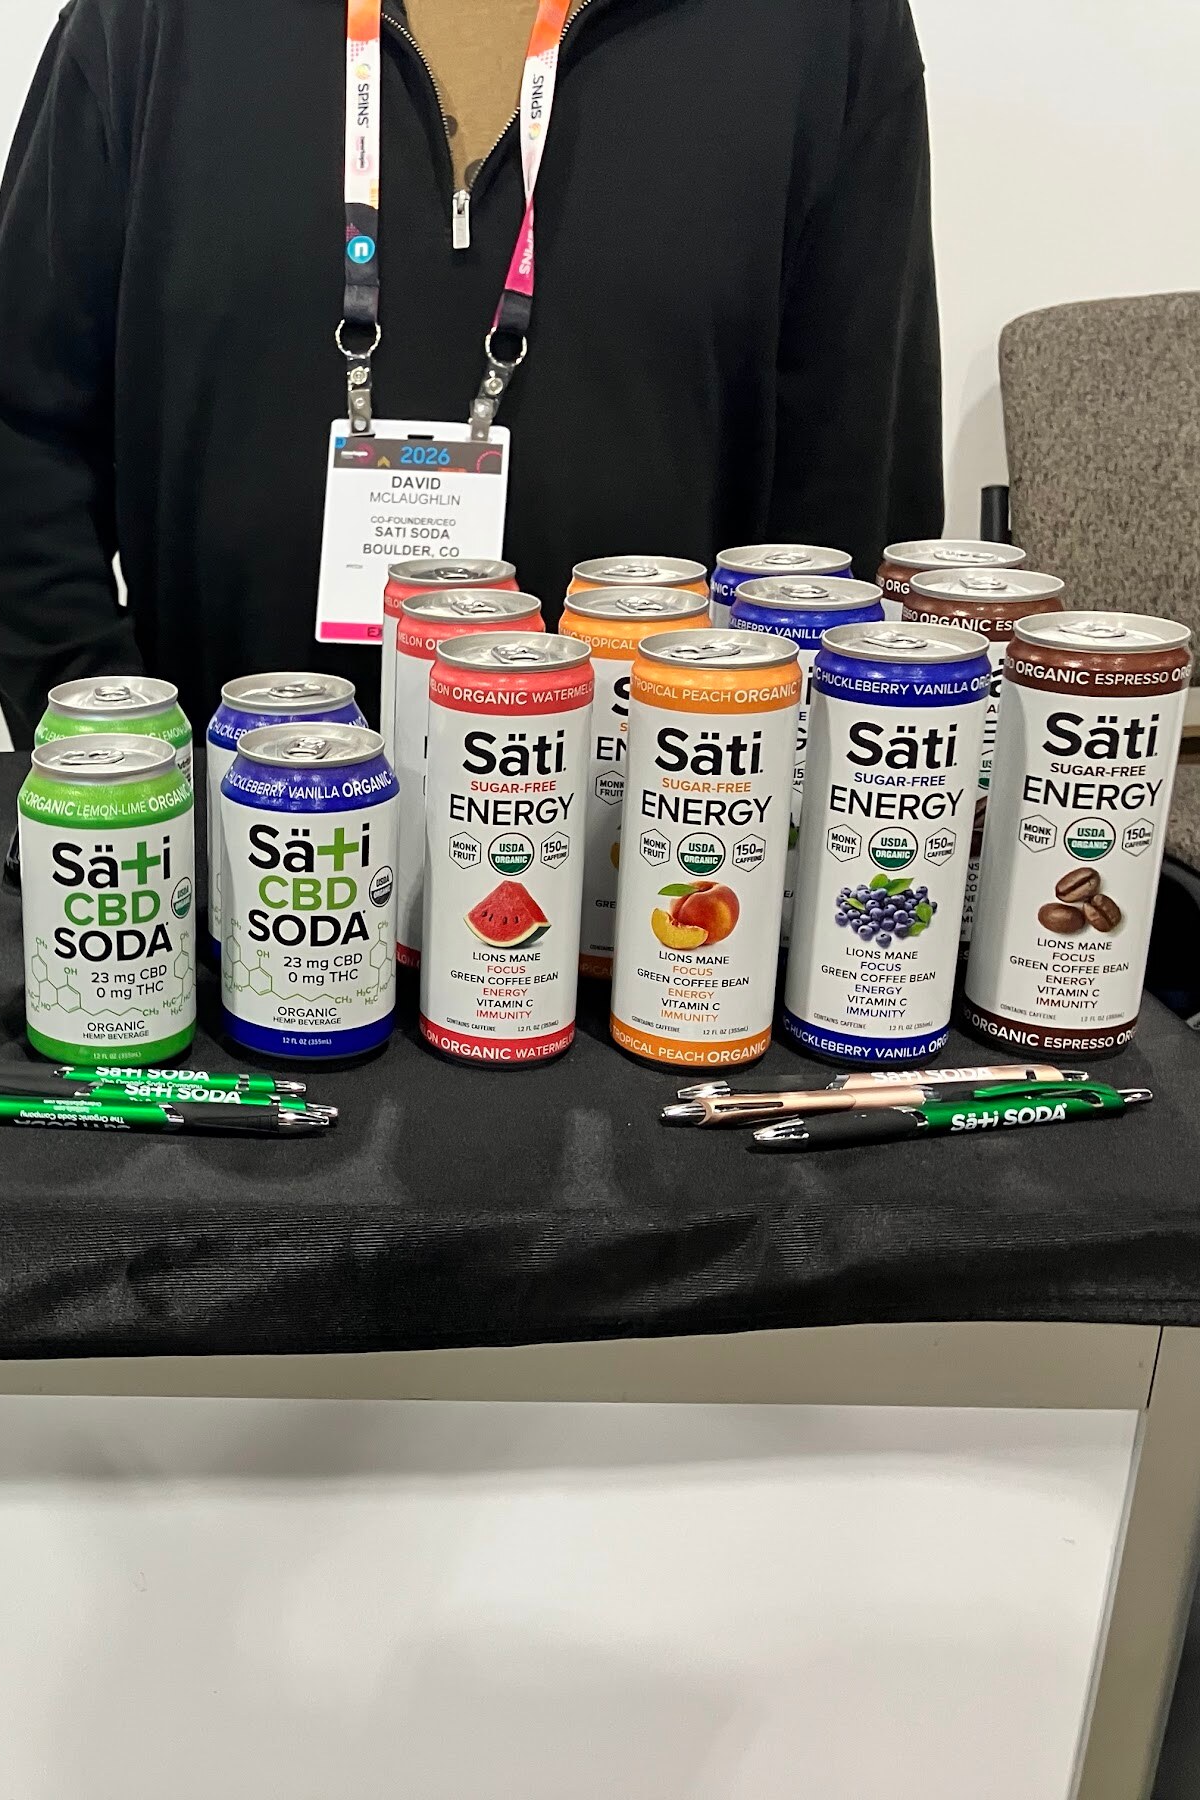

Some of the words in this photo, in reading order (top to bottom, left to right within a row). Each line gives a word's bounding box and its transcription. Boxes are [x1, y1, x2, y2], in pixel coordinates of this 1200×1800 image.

[531, 74, 545, 119] SPINS
[357, 83, 369, 126] SPINS
[400, 446, 451, 466] 2026
[391, 476, 441, 490] DAVID
[369, 491, 461, 505] MCLAUGHLIN
[370, 515, 456, 527] CO-FOUNDER/CEO
[375, 527, 407, 538] SATI
[410, 528, 450, 540] SODA
[363, 544, 435, 558] BOULDER,
[439, 547, 460, 558] CO
[1015, 662, 1090, 685] ORGANIC
[1095, 672, 1168, 685] ESPRESSO
[822, 670, 909, 695] HUCKLEBERRY
[914, 682, 968, 695] VANILLA
[452, 687, 527, 705] ORGANIC
[682, 689, 730, 702] PEACH
[734, 681, 796, 704] ORGANIC
[1050, 762, 1146, 777] SUGAR-FREE
[289, 785, 340, 799] VANILLA
[342, 772, 392, 797] ORGANIC
[662, 778, 751, 793] SUGAR-FREE
[854, 771, 946, 787] SUGAR-FREE
[471, 781, 556, 793] SUGAR-FREE
[1023, 775, 1163, 810] ENERGY
[26, 793, 75, 816] ORGANIC
[77, 801, 146, 816] LEMON-LIME
[149, 784, 191, 812] ORGANIC
[830, 785, 964, 820] ENERGY
[450, 793, 574, 826] ENERGY
[642, 790, 772, 826] ENERGY
[499, 843, 524, 853] USDA
[689, 843, 715, 853] USDA
[881, 838, 908, 848] USDA
[495, 856, 528, 864] ORGANIC
[684, 855, 718, 864] ORGANIC
[875, 849, 910, 859] ORGANIC
[258, 875, 357, 911] CBD
[64, 890, 161, 926] CBD
[248, 909, 369, 947] SODA
[54, 923, 173, 962] SODA
[473, 952, 506, 962] LIONS
[509, 953, 541, 962] MANE
[659, 951, 692, 963] LIONS
[696, 955, 729, 965] MANE
[846, 947, 881, 959] LIONS
[884, 951, 918, 959] MANE
[284, 957, 302, 968] 23
[307, 959, 329, 971] mg
[334, 953, 363, 967] CBD
[861, 962, 901, 971] FOCUS
[91, 972, 109, 983] 23
[114, 973, 135, 985] mg
[139, 965, 167, 979] CBD
[487, 966, 526, 974] FOCUS
[673, 966, 713, 976] FOCUS
[821, 965, 856, 980] GREEN
[860, 973, 906, 983] COFFEE
[909, 972, 936, 983] BEAN
[451, 970, 484, 984] GREEN
[488, 977, 531, 985] COFFEE
[534, 972, 558, 983] BEAN
[637, 969, 670, 984] GREEN
[674, 978, 718, 988] COFFEE
[722, 977, 749, 988] BEAN
[483, 988, 527, 997] ENERGY
[668, 988, 714, 999] ENERGY
[855, 984, 902, 994] ENERGY
[278, 1007, 337, 1017] ORGANIC
[476, 1010, 532, 1020] IMMUNITY
[661, 1010, 719, 1022] IMMUNITY
[846, 1006, 906, 1018] IMMUNITY
[87, 1020, 145, 1032] ORGANIC
[1003, 1103, 1067, 1127] SODA
